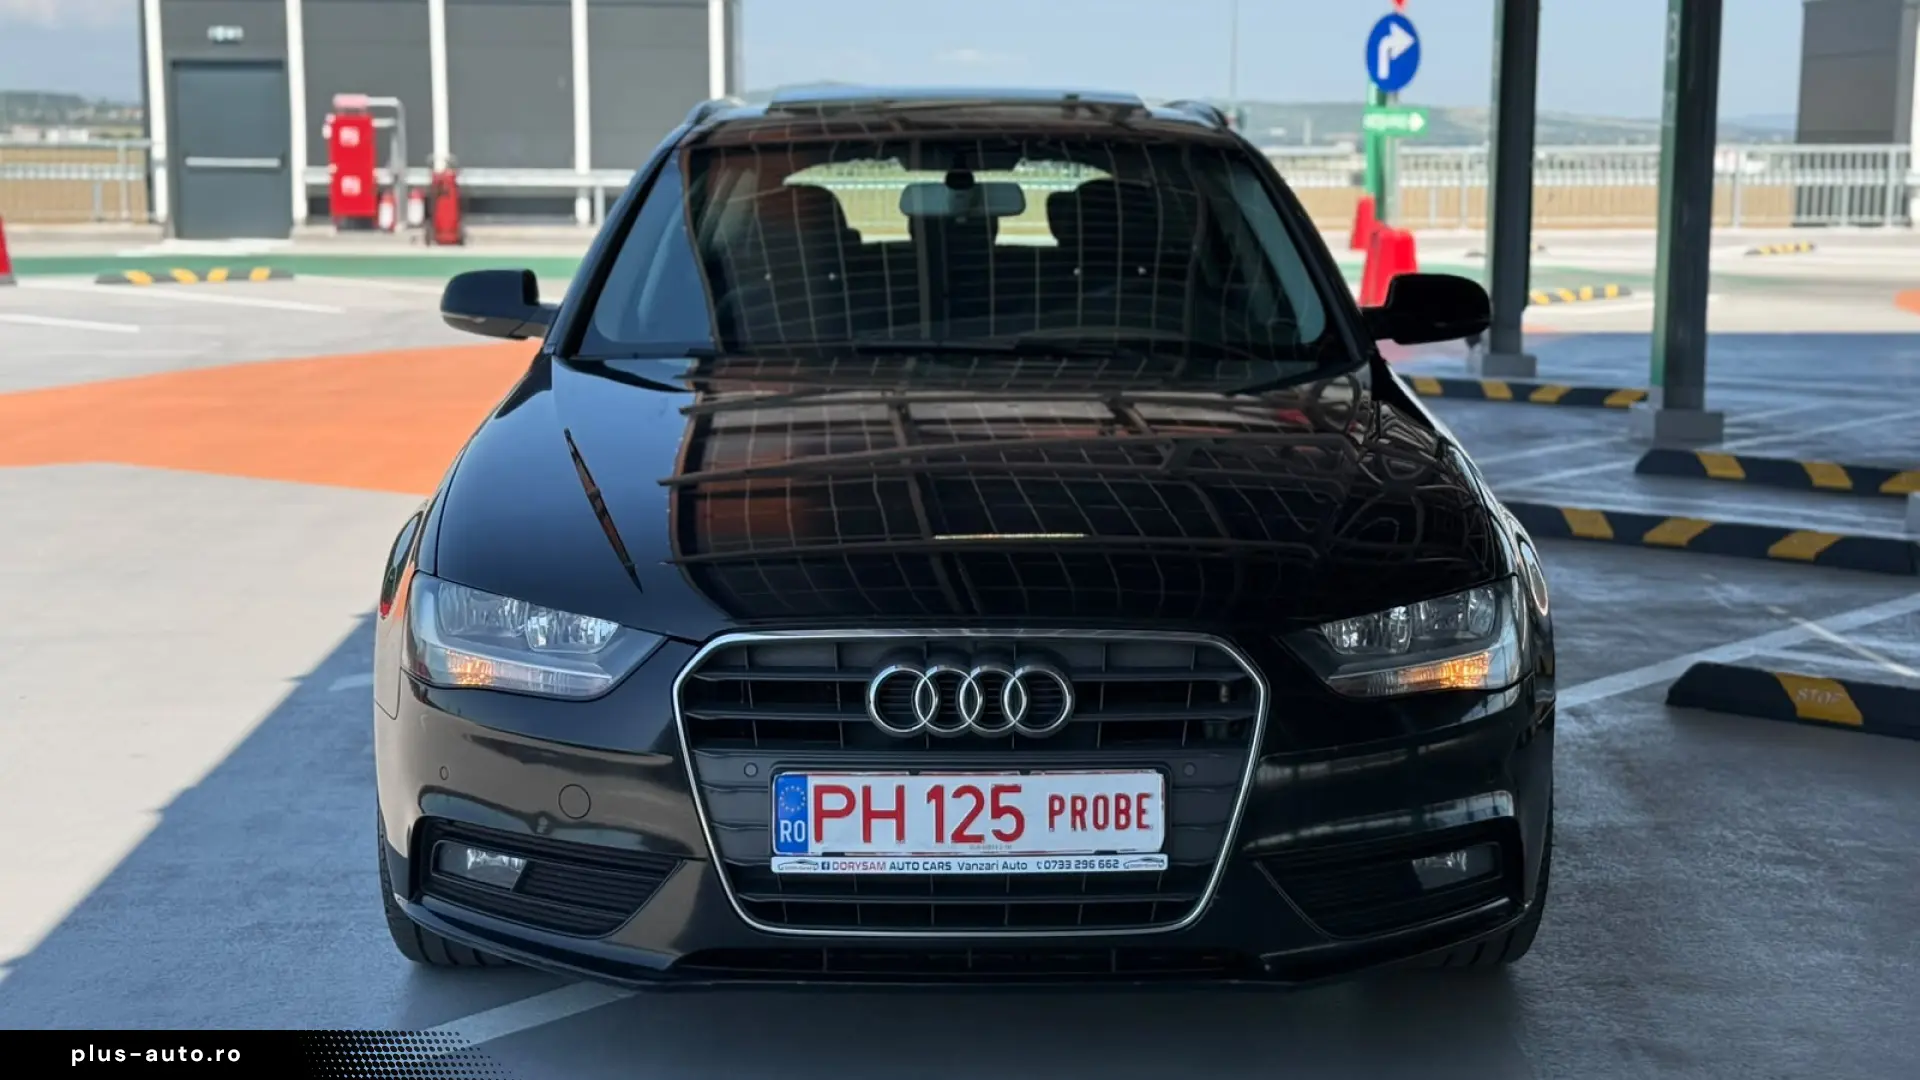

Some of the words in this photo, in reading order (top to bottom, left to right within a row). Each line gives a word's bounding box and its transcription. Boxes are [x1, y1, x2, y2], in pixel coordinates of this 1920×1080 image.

[814, 785, 905, 843] PH
[926, 784, 1025, 843] 125
[1048, 793, 1153, 832] PROBE
[780, 820, 805, 843] RO
[832, 861, 886, 871] DORYSAM
[889, 861, 920, 871] AUTO
[922, 861, 952, 871] CARS
[958, 861, 998, 871] Vanzari
[1002, 861, 1028, 871] Auto
[1043, 860, 1071, 870] 0733
[1074, 860, 1096, 870] 296
[1098, 859, 1120, 869] 662
